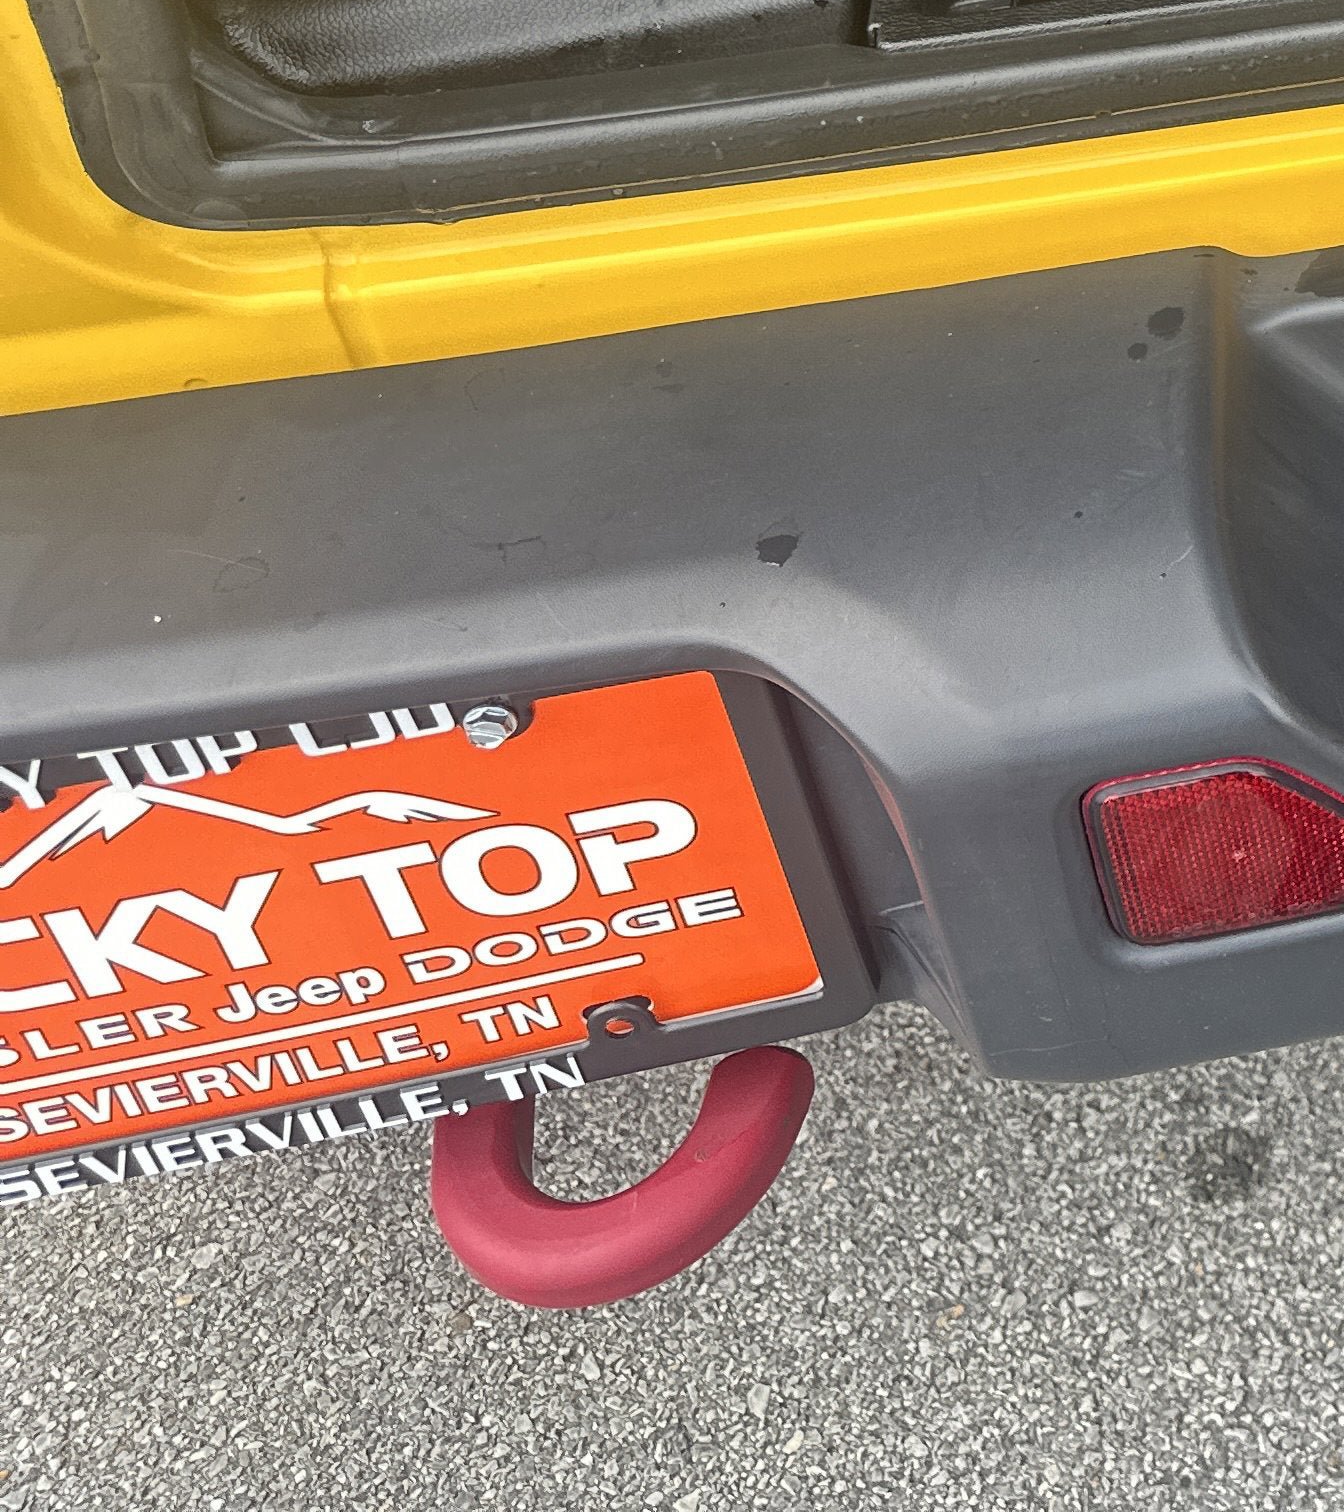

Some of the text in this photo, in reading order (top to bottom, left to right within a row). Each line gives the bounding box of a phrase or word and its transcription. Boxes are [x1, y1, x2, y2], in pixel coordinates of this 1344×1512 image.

[76, 729, 258, 792] TOP
[311, 799, 698, 940] TOP
[212, 966, 387, 1023] Jeep
[400, 887, 744, 984] DODGE
[460, 995, 562, 1044] TN
[484, 1052, 586, 1103] TN
